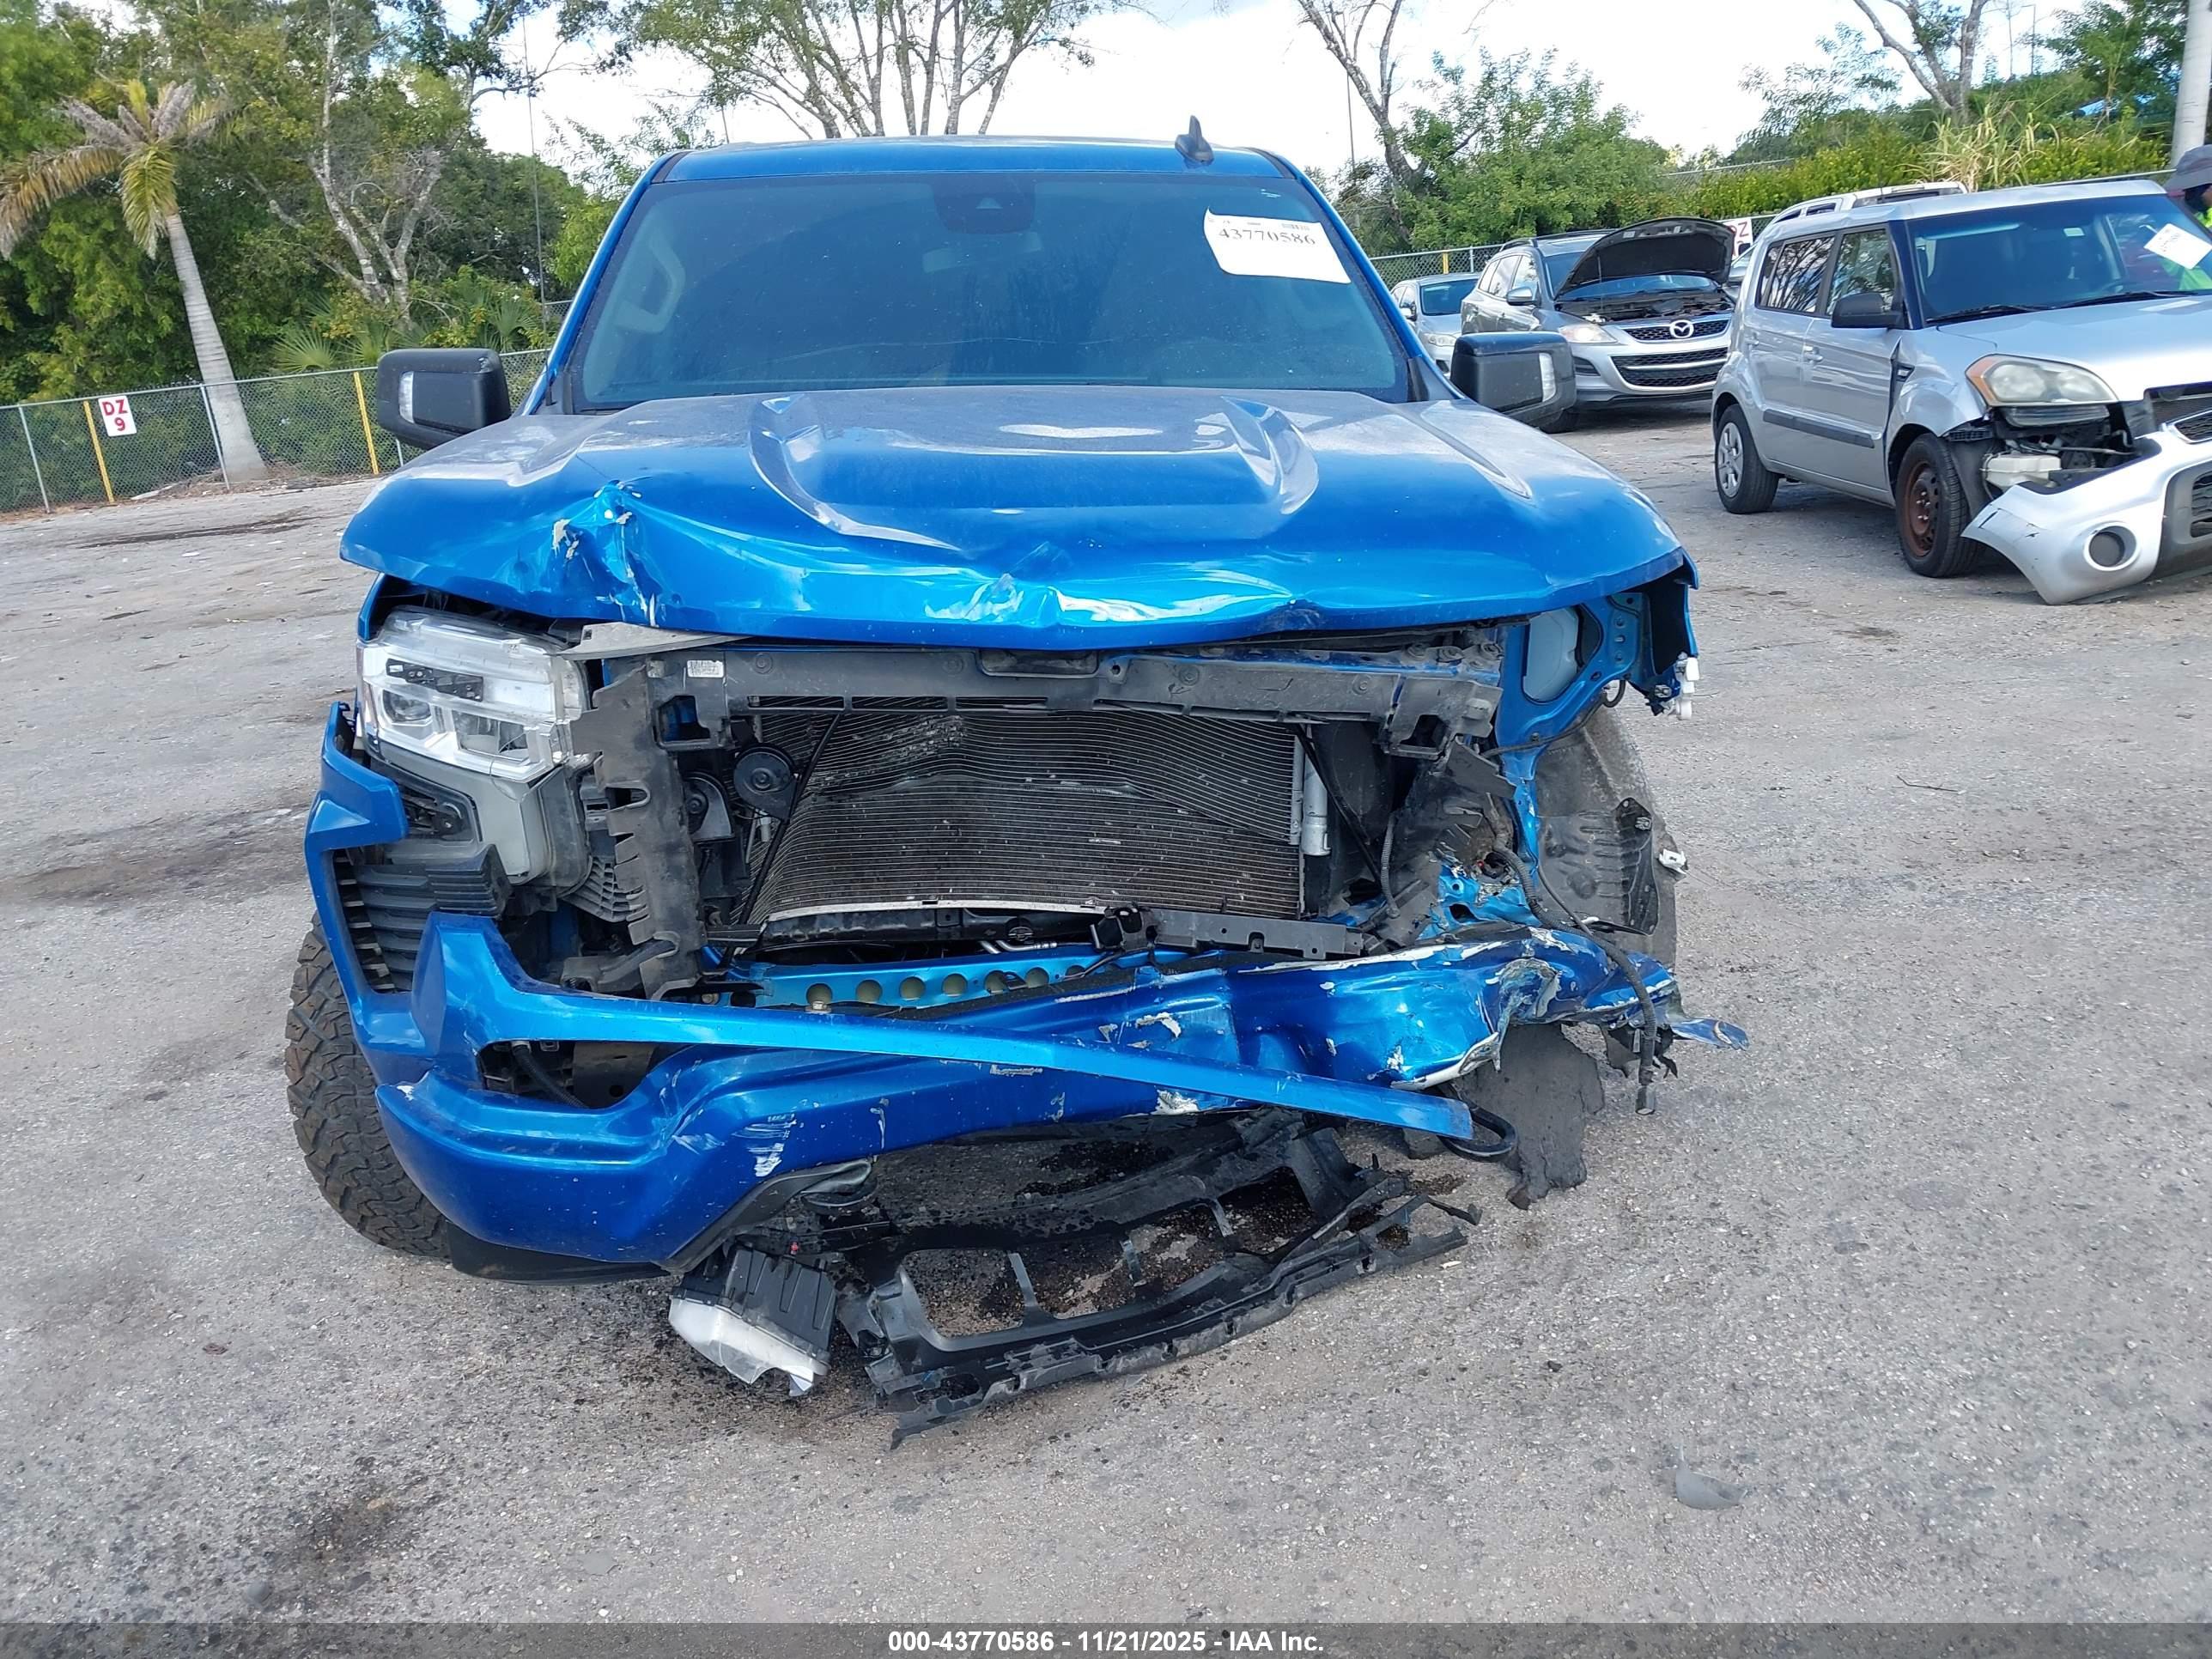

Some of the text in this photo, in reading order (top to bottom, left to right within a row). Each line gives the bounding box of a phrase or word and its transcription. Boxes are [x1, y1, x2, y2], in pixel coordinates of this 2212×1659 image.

[1218, 228, 1316, 245] 43770586
[101, 398, 128, 416] DZ
[114, 416, 126, 431] 9
